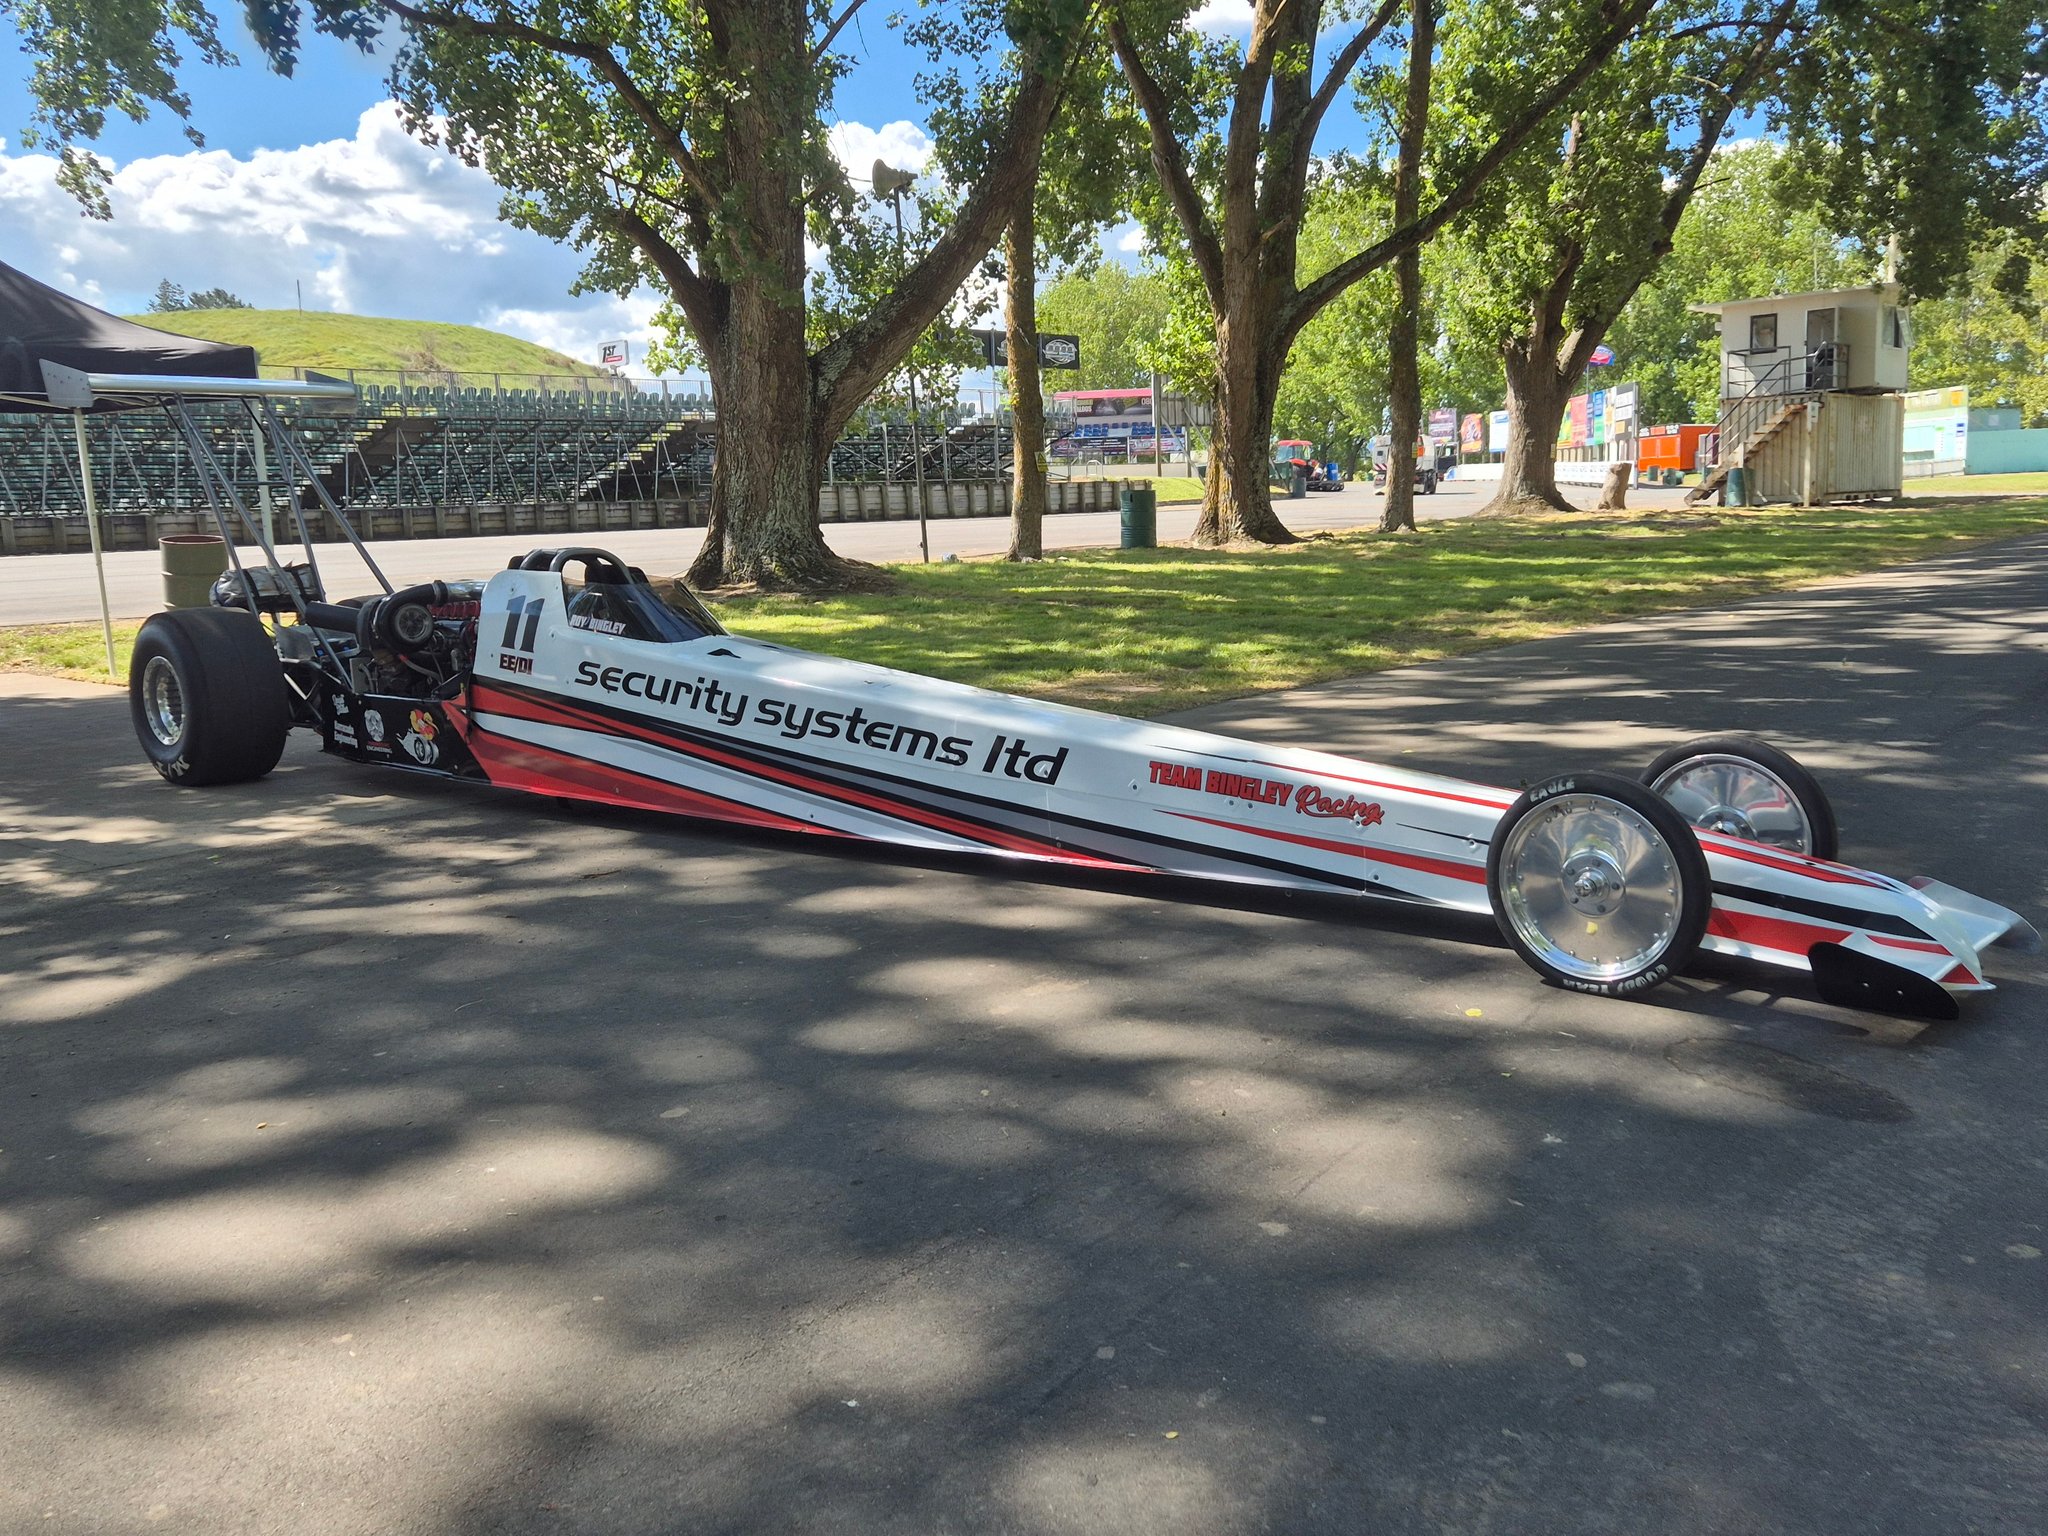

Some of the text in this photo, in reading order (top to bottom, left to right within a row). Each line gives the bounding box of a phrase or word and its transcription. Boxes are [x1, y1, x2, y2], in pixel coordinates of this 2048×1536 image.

[501, 595, 545, 653] 11
[570, 614, 626, 635] ROY BINGLEY
[575, 660, 1069, 786] security systems ltd
[1149, 760, 1385, 826] TEAM BINGLEY Racing
